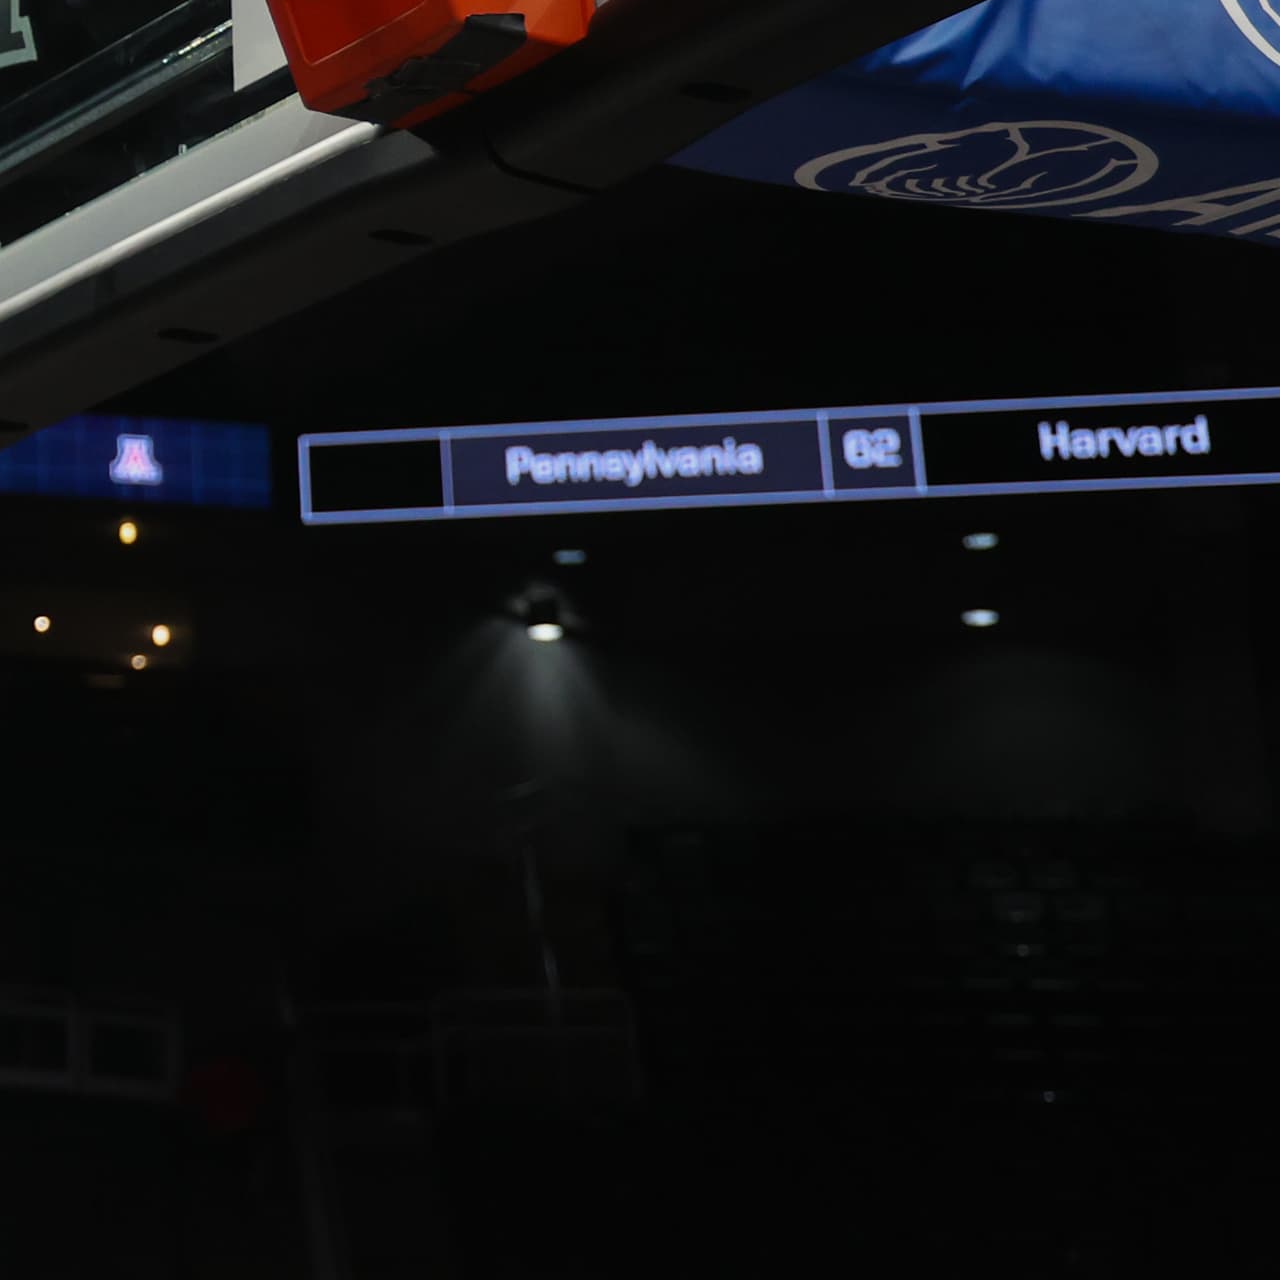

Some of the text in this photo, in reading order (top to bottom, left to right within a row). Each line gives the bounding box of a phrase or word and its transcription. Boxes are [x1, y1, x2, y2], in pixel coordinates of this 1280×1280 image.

[505, 414, 1211, 487] Pennsylvania 62 Harvard
